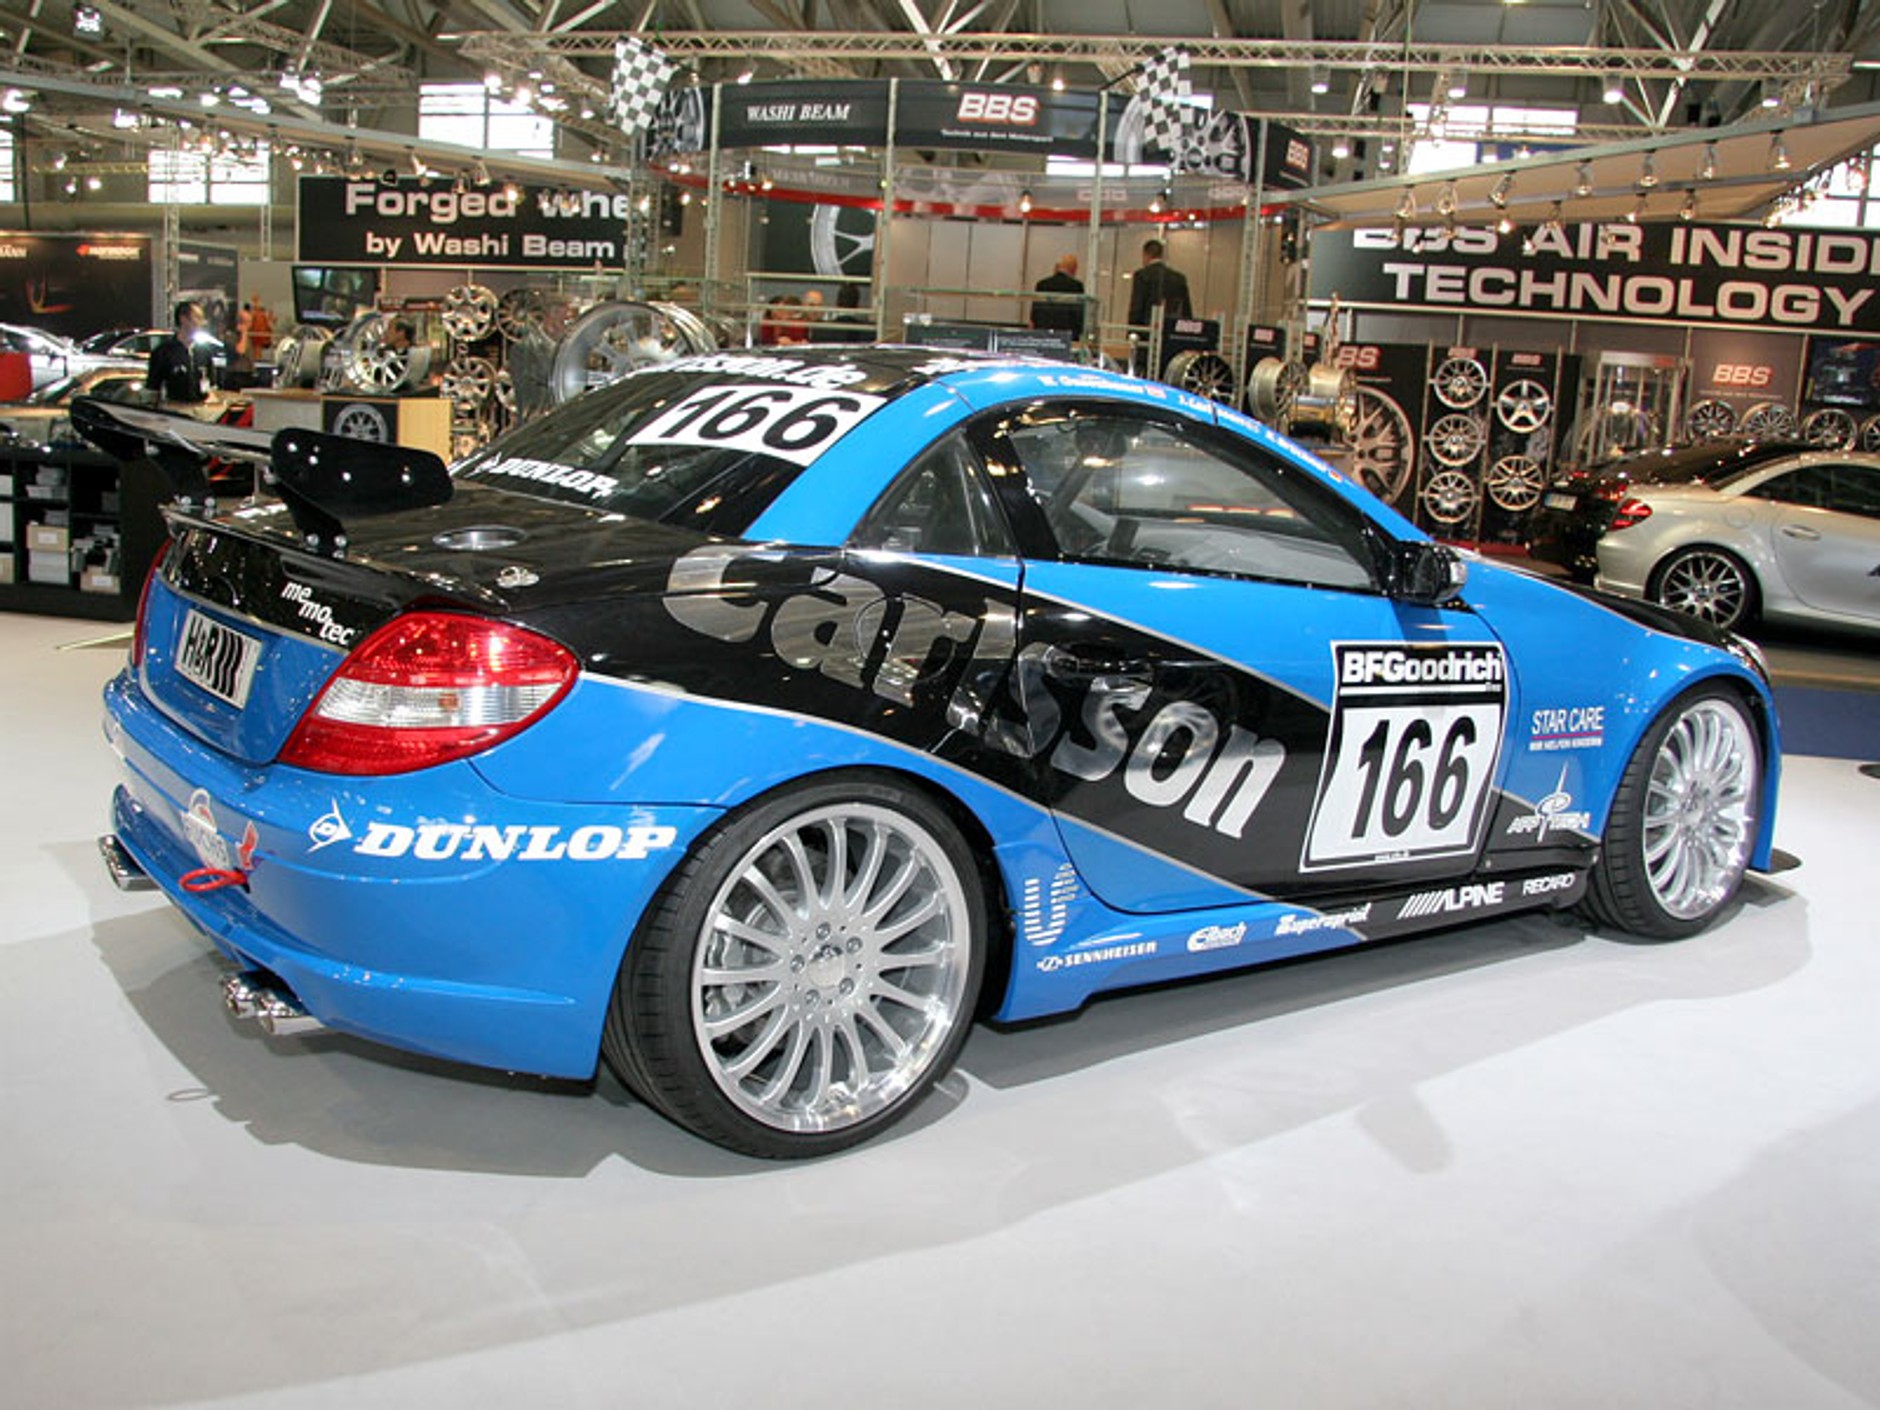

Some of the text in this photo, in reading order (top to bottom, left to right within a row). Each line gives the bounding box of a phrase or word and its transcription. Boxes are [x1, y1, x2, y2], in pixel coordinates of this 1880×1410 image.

[748, 104, 851, 122] WASHI BEAM
[957, 92, 1040, 125] BBS
[345, 183, 516, 224] Forged
[366, 231, 615, 258] by Washi Beam
[1522, 222, 1643, 262] AIR
[1379, 263, 1875, 326] TECHNOLOGY
[1713, 364, 1771, 387] BBS
[658, 390, 861, 451] 166
[488, 458, 620, 499] DUNLOP
[1342, 651, 1502, 683] BFGoodrich
[663, 545, 1288, 838] Carlsson
[1531, 706, 1604, 735] STAR CARE
[1351, 716, 1477, 840] 166
[354, 821, 677, 861] DUNLOP
[1434, 881, 1505, 914] ALPINE
[1065, 941, 1157, 968] SENNHEISER
